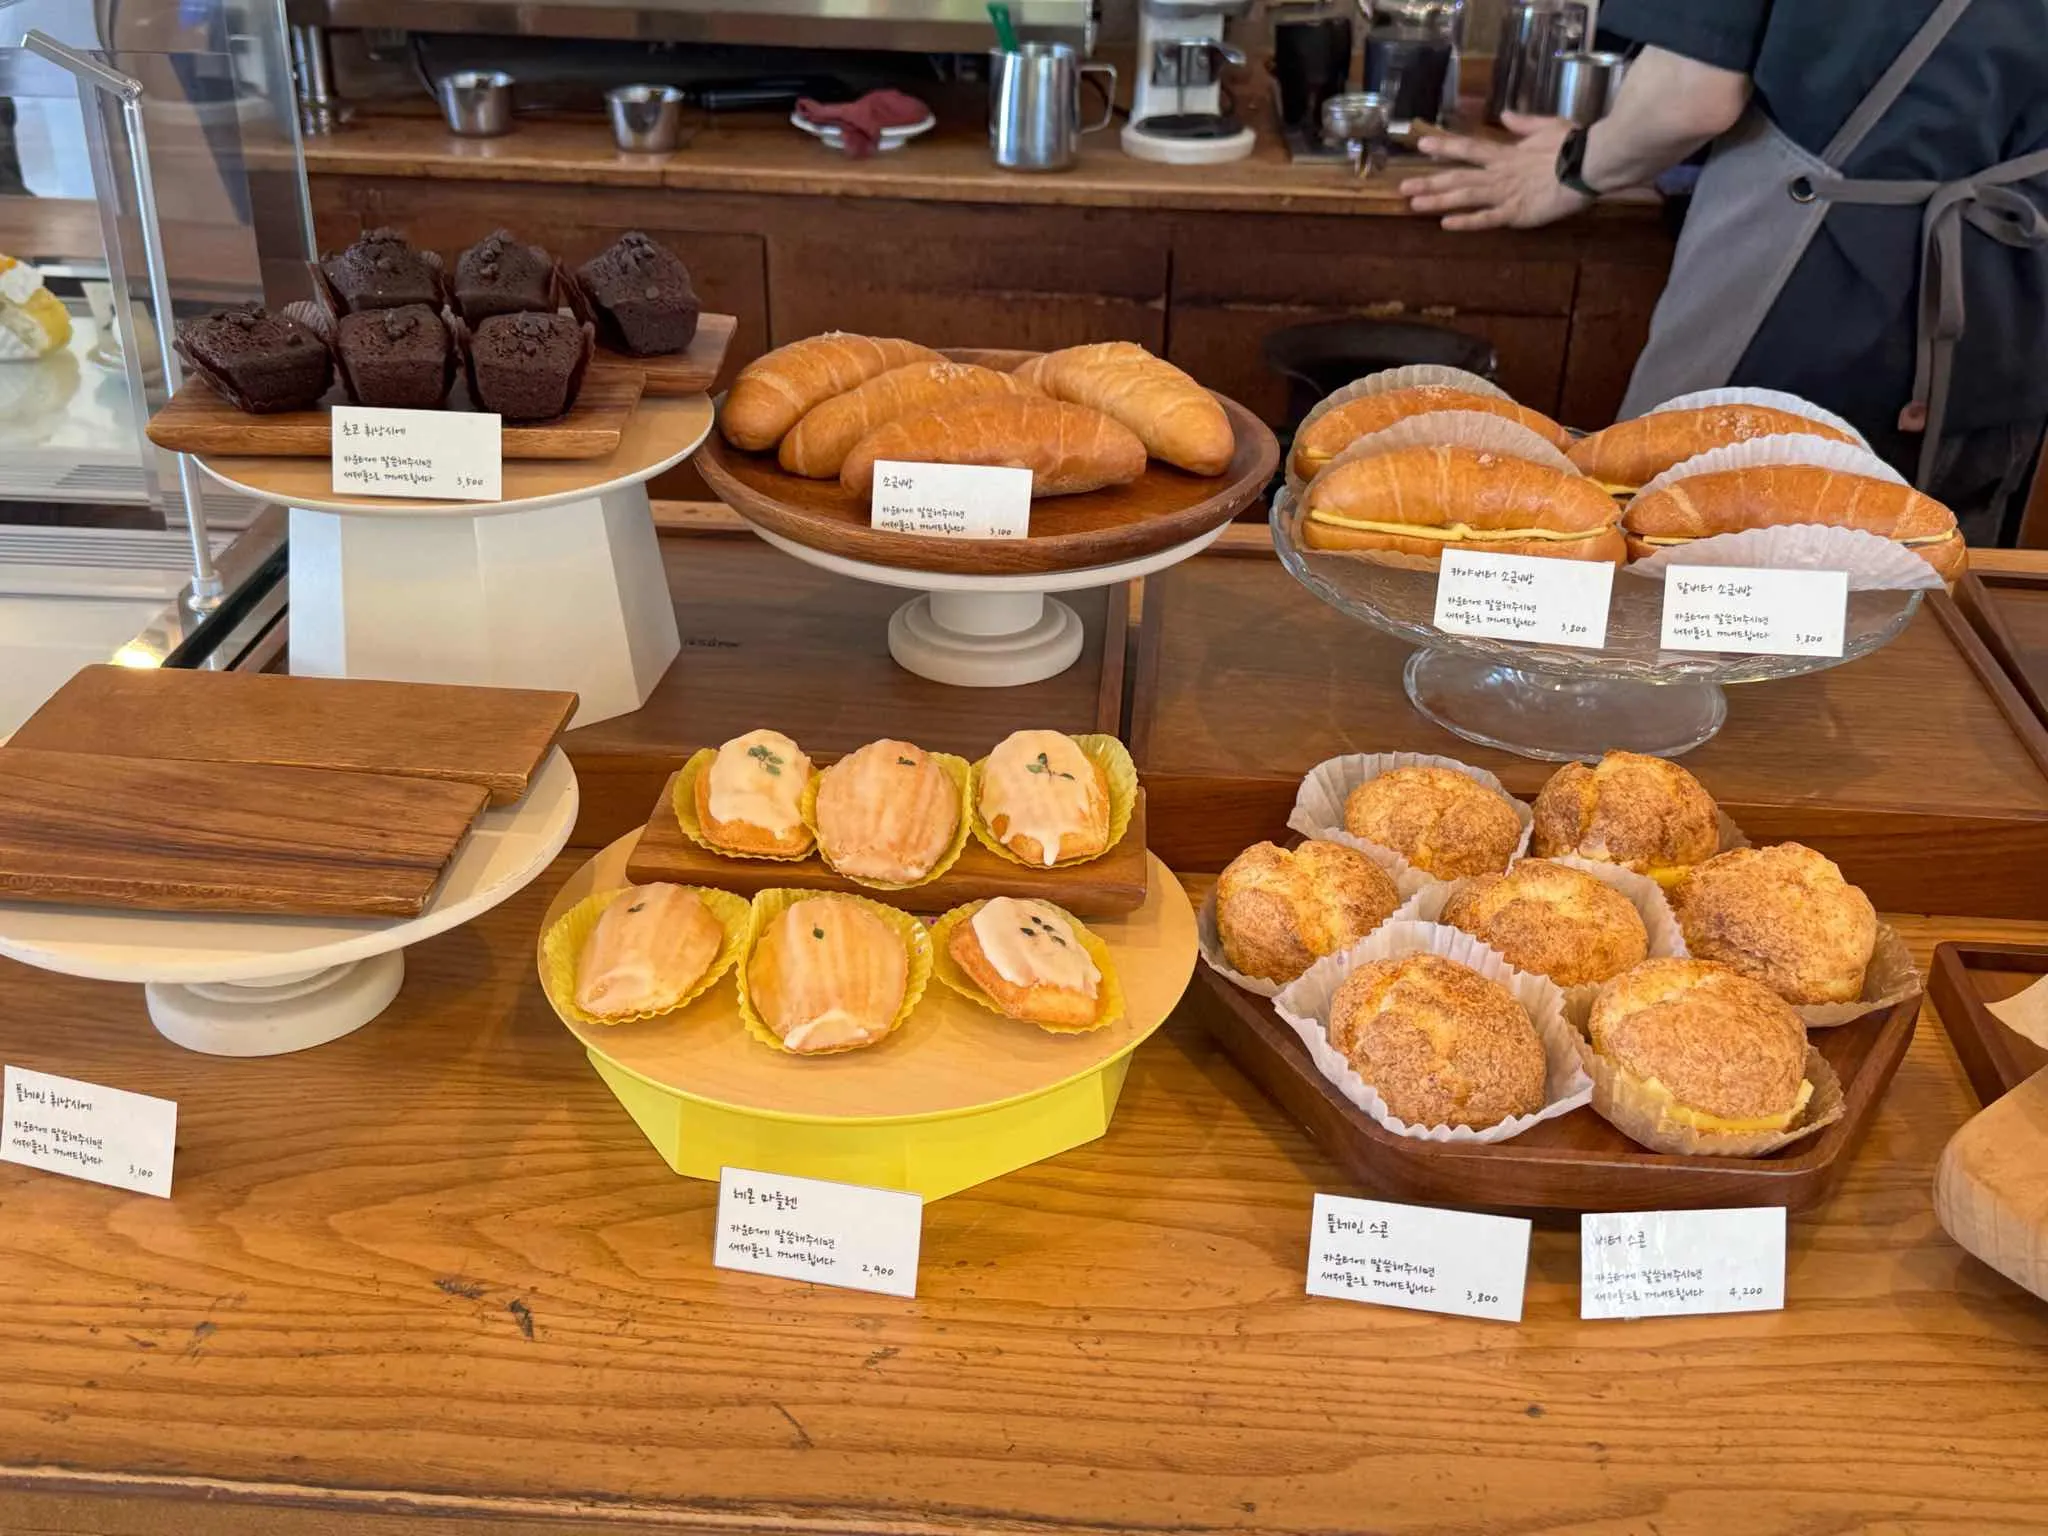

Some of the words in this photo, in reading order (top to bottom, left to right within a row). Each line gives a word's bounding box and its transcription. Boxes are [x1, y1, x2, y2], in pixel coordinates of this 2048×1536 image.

[364, 423, 406, 438] 휘낭시에
[456, 476, 484, 489] 3,500
[882, 476, 914, 490] 소금빵
[1450, 567, 1497, 579] 카야버터
[1501, 570, 1535, 585] 소금빵
[1677, 582, 1713, 595] 팥버터
[1717, 583, 1753, 597] 소금빵
[1560, 623, 1587, 635] 3,800
[1795, 633, 1823, 645] 3,800
[15, 1083, 46, 1104] 플레인
[49, 1091, 93, 1112] 휘낭시에
[128, 1165, 153, 1179] 3,100
[733, 1187, 755, 1205] 레몬
[761, 1191, 799, 1210] 마들렌
[1327, 1213, 1365, 1235] 플레인
[1369, 1220, 1389, 1238] 스콘
[730, 1224, 770, 1236] 카운터에
[774, 1229, 835, 1250] 말씀해주시면
[1627, 1230, 1647, 1248] 스콘
[728, 1242, 772, 1259] 새제품으로
[777, 1249, 835, 1267] 꺼내드립니다
[861, 1264, 895, 1277] 2,900
[1322, 1254, 1366, 1266] 카운터에
[1370, 1257, 1436, 1278] 말씀해주시면
[1321, 1272, 1368, 1288] 새제품으로
[1373, 1278, 1436, 1294] 꺼내드립니다
[1641, 1267, 1703, 1284] 말씀해주시면
[1465, 1290, 1499, 1305] 3,800
[1644, 1287, 1704, 1302] 꺼내드립니다
[1728, 1287, 1763, 1301] 4,200
